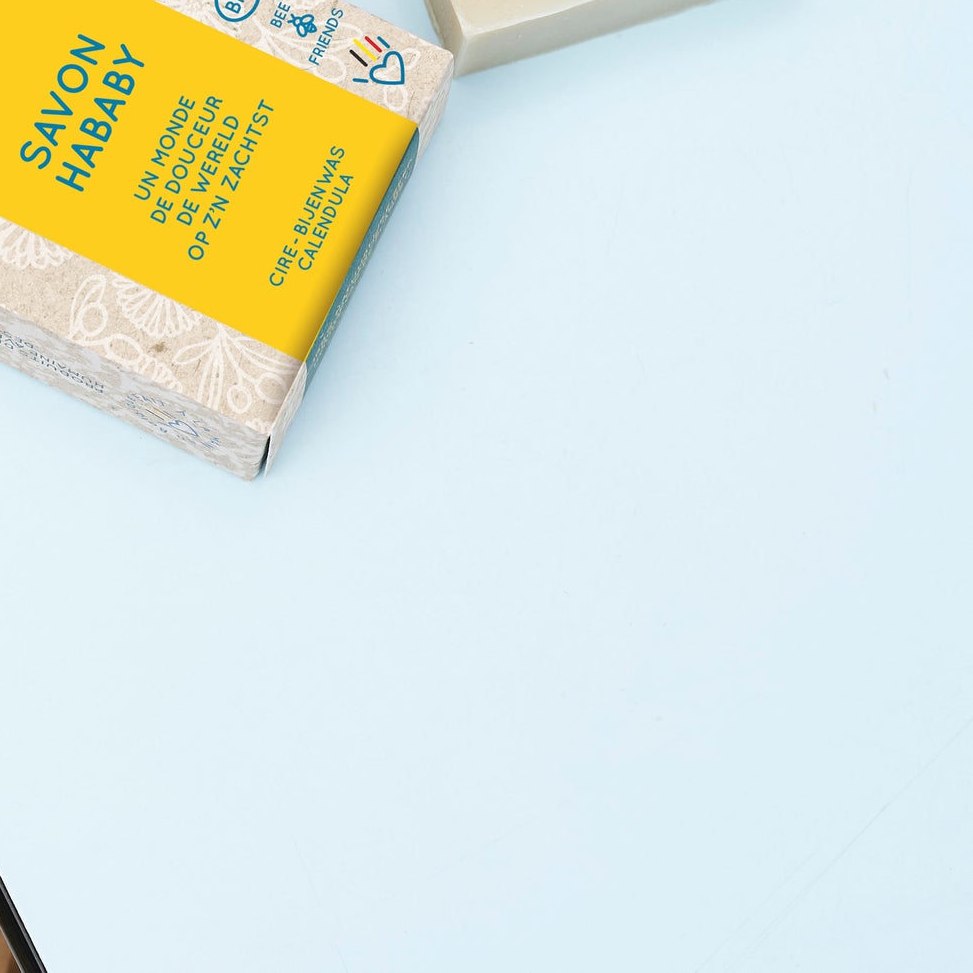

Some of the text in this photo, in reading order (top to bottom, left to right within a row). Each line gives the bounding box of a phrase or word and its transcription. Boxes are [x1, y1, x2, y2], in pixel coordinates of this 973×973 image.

[270, 2, 291, 28] BEE
[308, 7, 344, 66] FRIENDS
[20, 34, 105, 169] SAVON
[56, 44, 145, 192] HABABY
[134, 95, 196, 201] UN MONDE
[150, 96, 223, 224] DE DOUCEUR
[176, 115, 239, 226] DE WERELD
[188, 230, 210, 260] OP
[221, 99, 273, 191] ZACHTST
[269, 244, 298, 287] CIRE
[298, 174, 354, 271] CALENDULA
